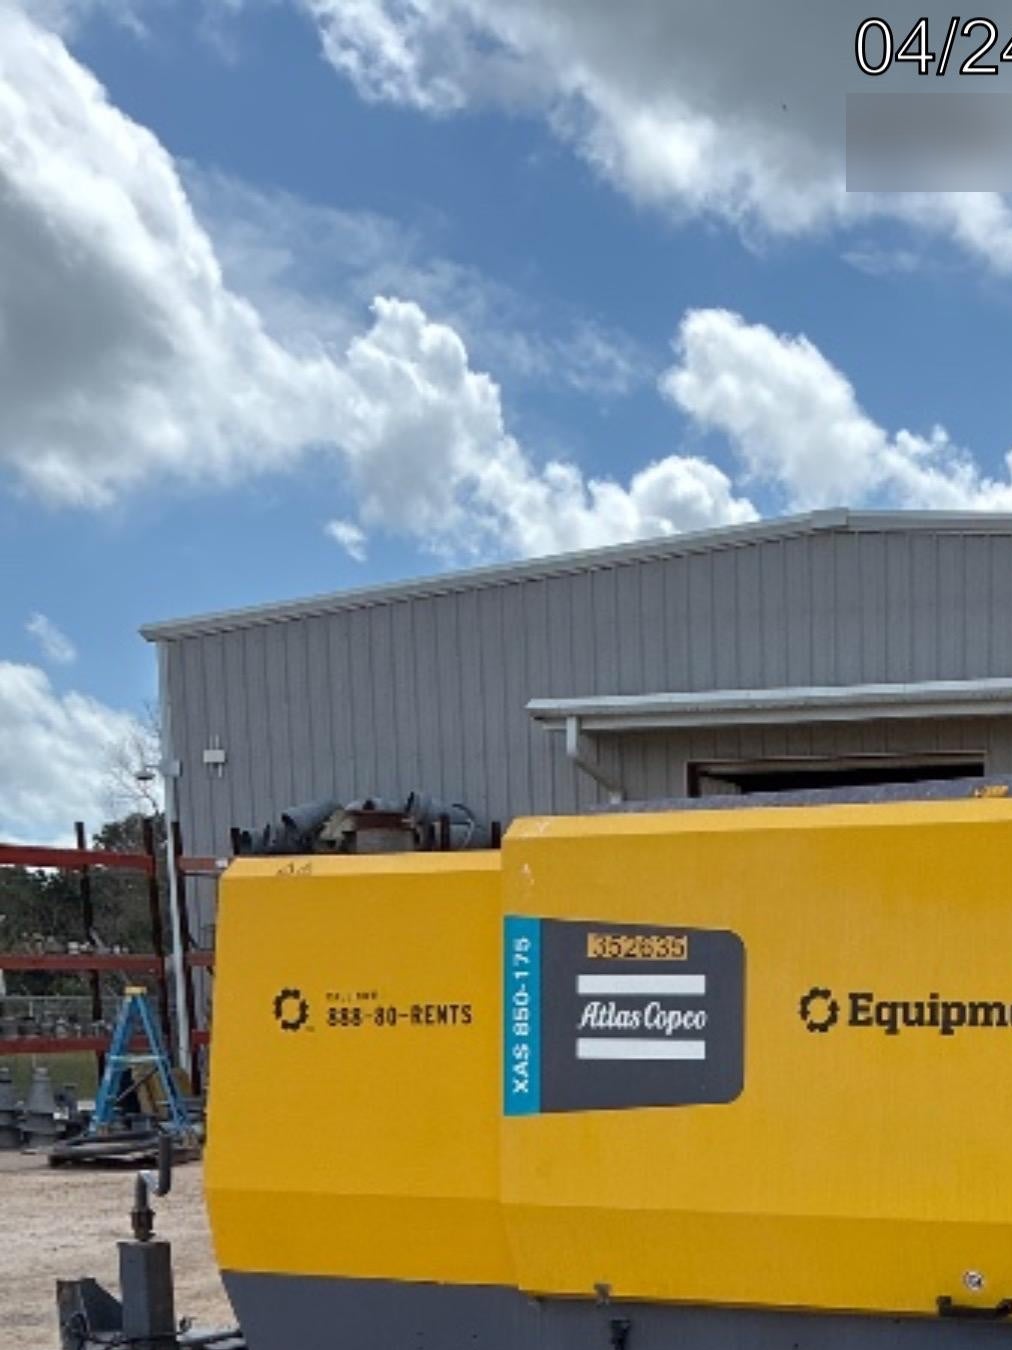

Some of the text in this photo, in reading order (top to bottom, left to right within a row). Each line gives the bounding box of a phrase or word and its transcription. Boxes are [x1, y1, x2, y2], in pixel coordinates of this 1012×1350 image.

[592, 934, 685, 958] 352635
[512, 937, 532, 1094] XAS 850-175
[577, 1000, 708, 1036] Atlas Copco
